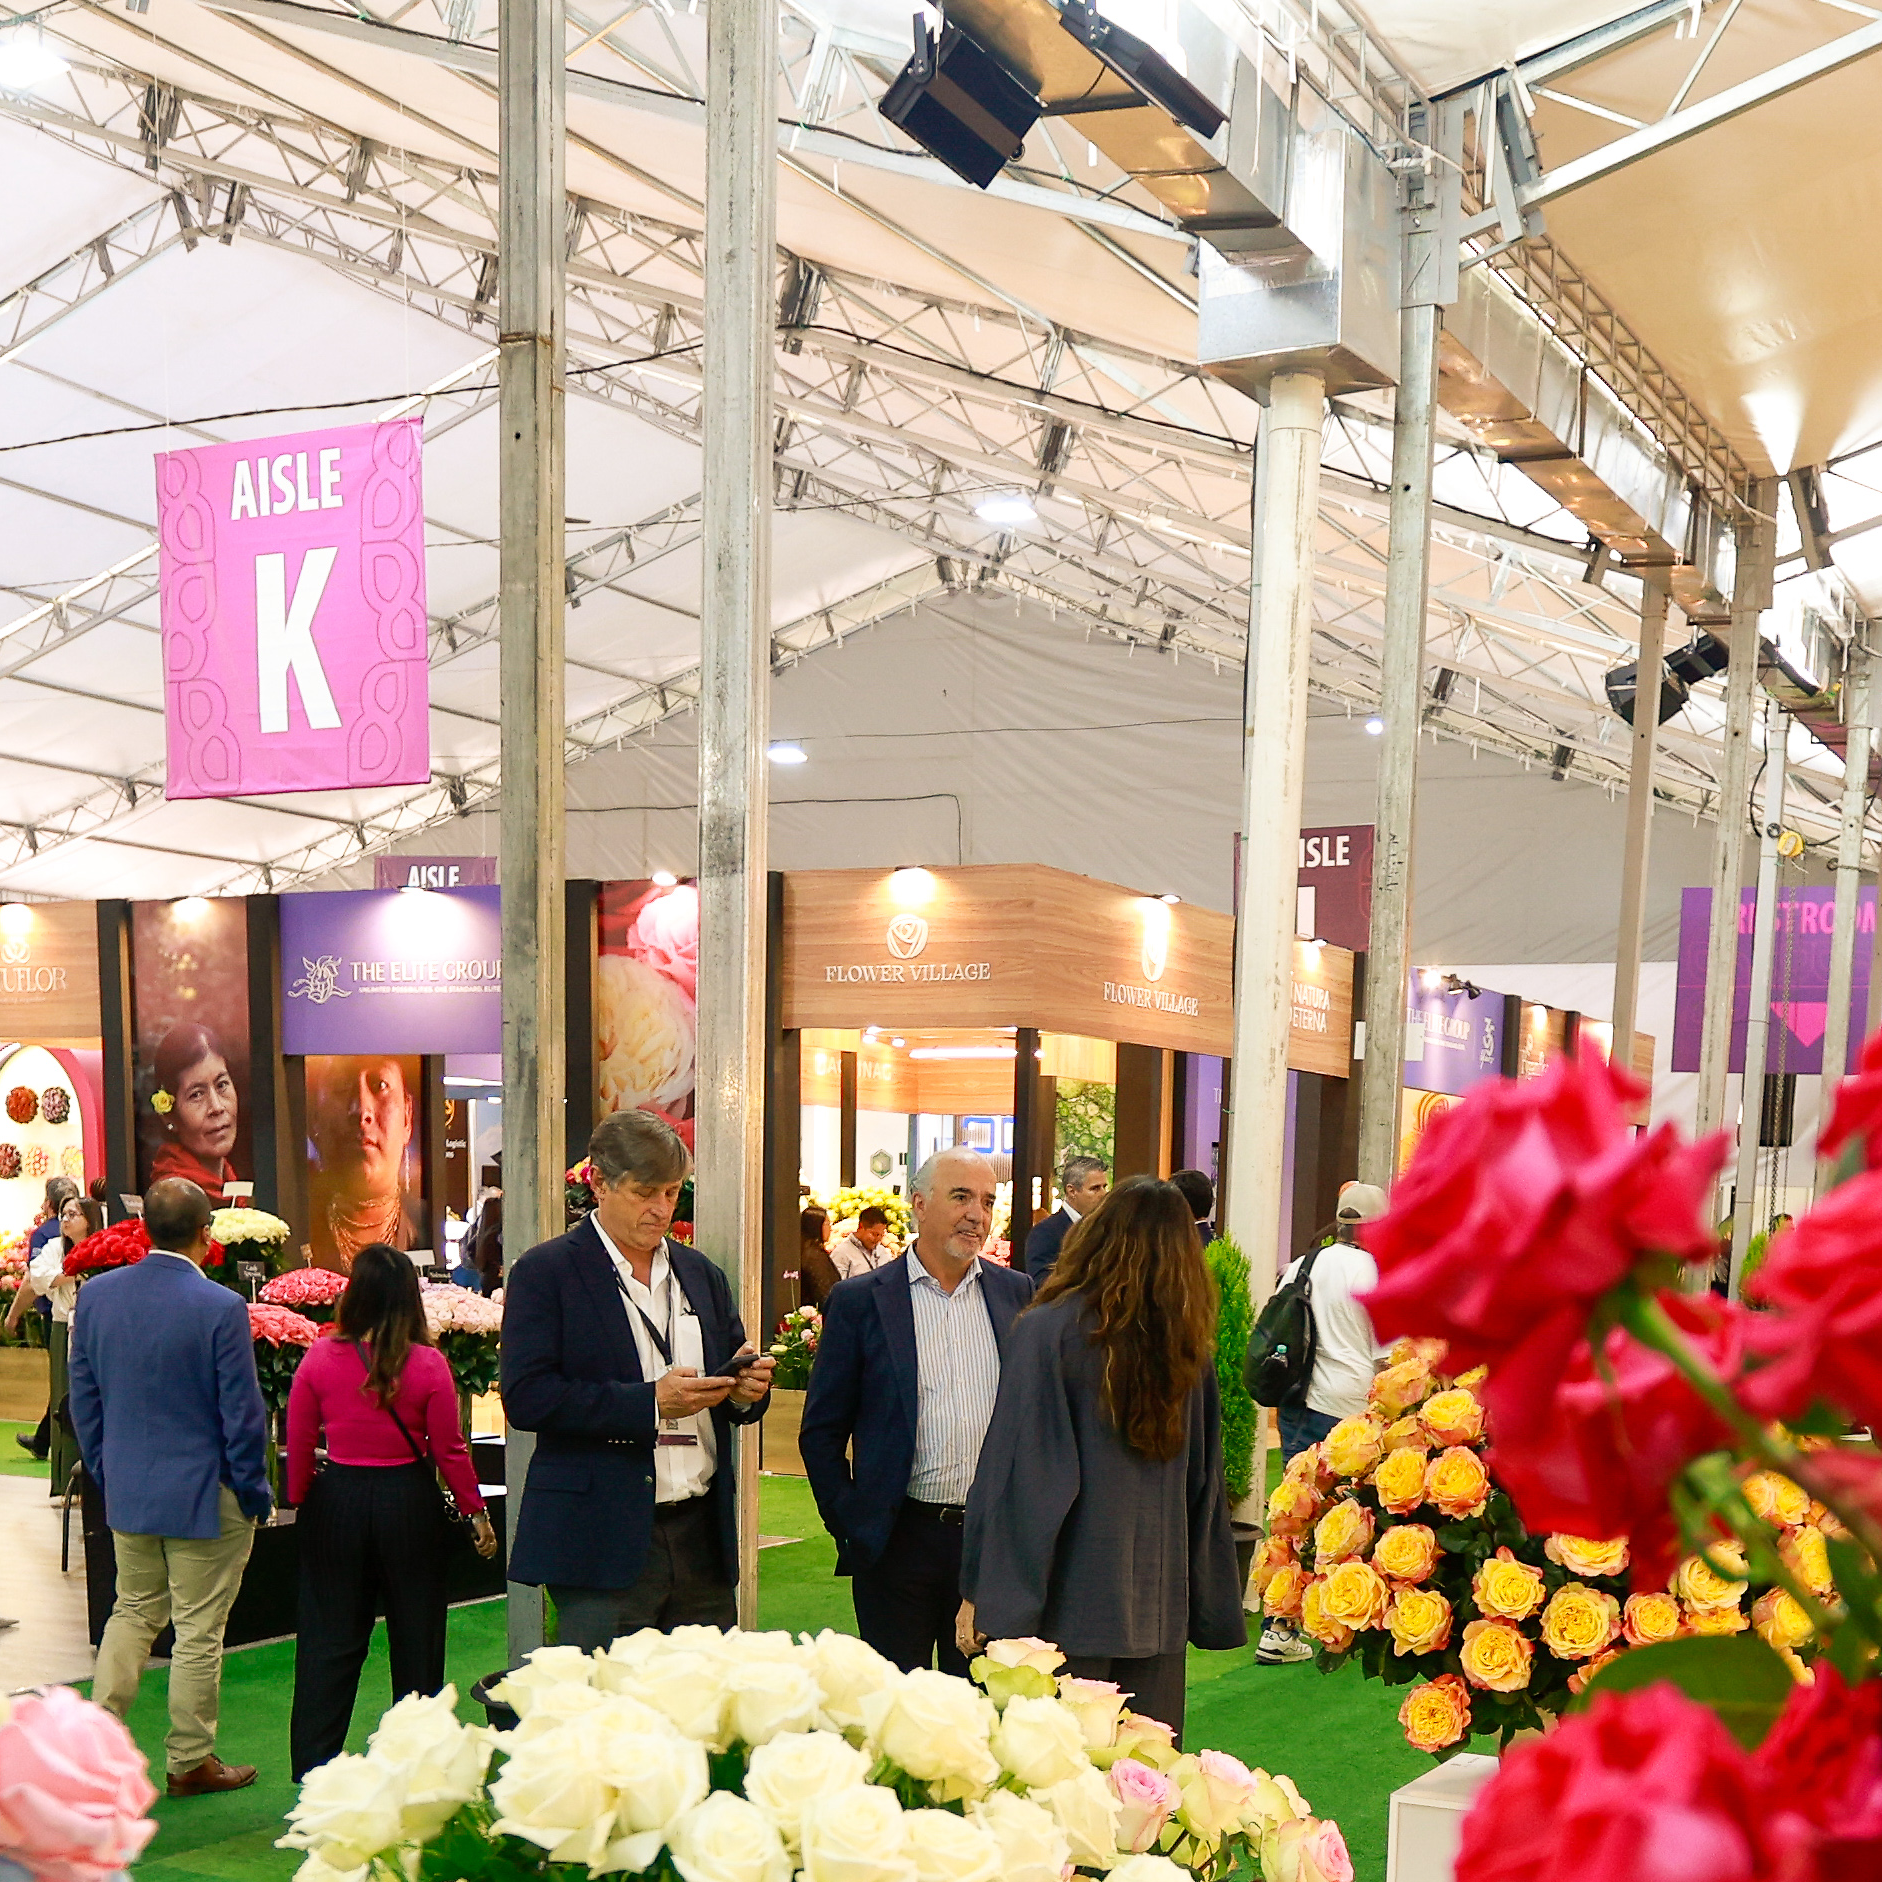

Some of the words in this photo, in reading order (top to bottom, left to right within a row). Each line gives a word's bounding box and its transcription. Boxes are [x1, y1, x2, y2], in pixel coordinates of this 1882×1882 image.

[230, 448, 344, 521] AISLE
[255, 547, 344, 734] K
[1298, 835, 1351, 869] ISLE
[350, 961, 386, 982] THE
[390, 960, 439, 982] ELITE
[824, 965, 906, 984] FLOWER
[911, 962, 992, 981] VILLAGE
[1103, 981, 1152, 1010] FLOWER
[1154, 990, 1200, 1016] VILLAGE
